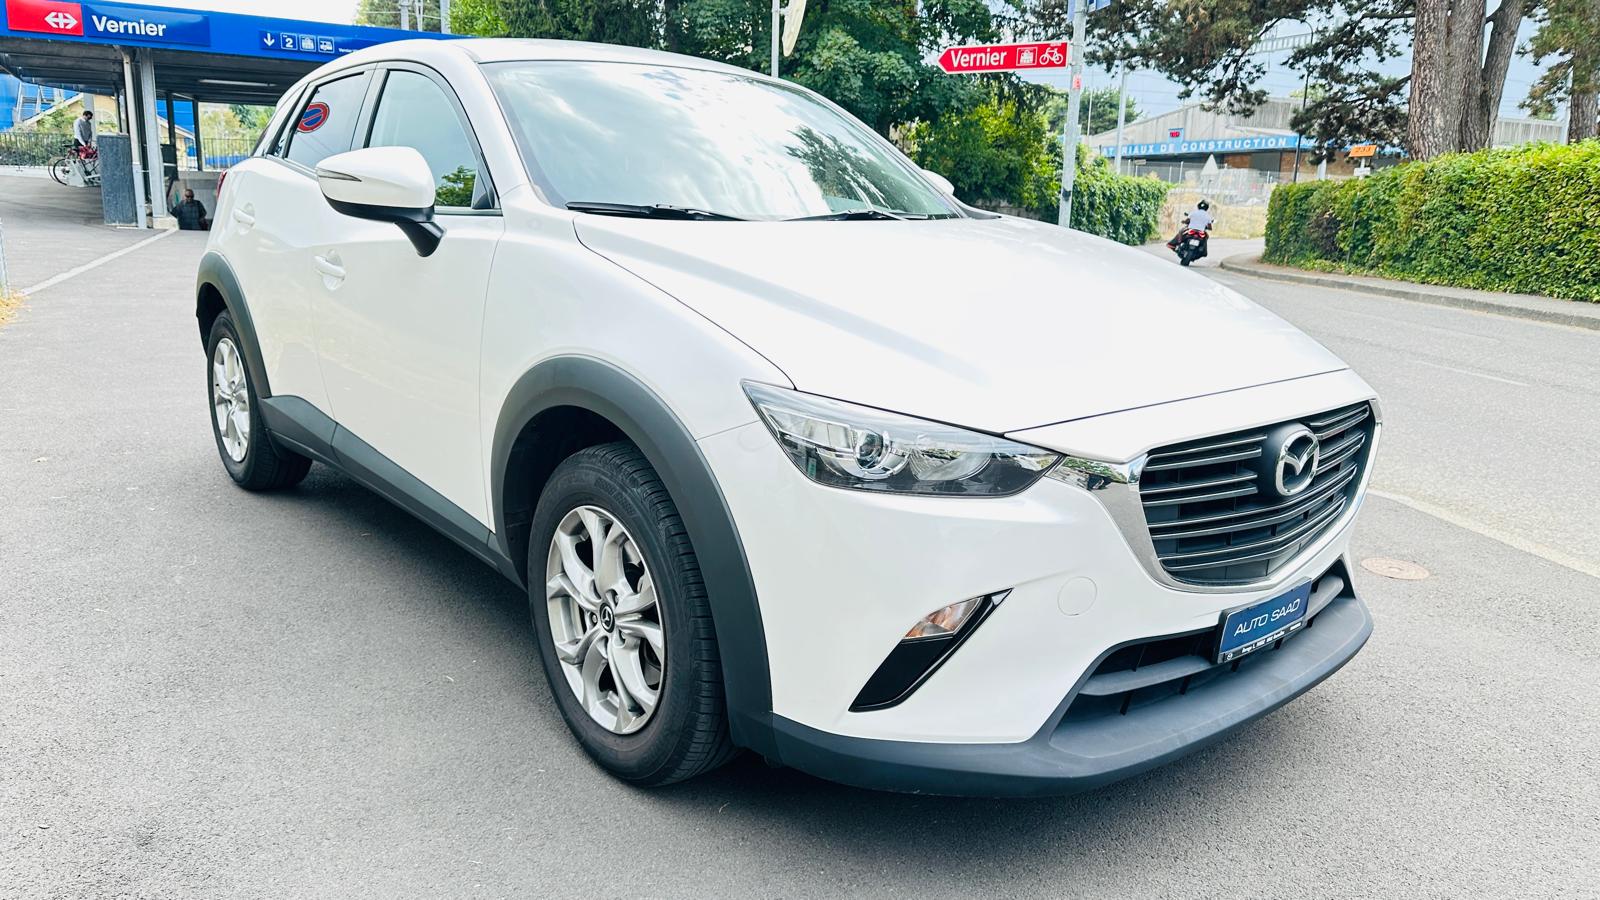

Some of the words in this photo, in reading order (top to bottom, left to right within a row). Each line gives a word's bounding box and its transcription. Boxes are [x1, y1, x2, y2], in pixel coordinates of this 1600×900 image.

[91, 14, 167, 37] Vernier
[285, 37, 294, 48] 2
[950, 47, 1007, 68] Vernier
[1103, 144, 1154, 156] ATRIAUX
[1160, 143, 1175, 153] DE
[1180, 137, 1288, 152] CONSTRUCTION
[1234, 614, 1268, 636] AUTO
[1271, 599, 1300, 621] SAAD
